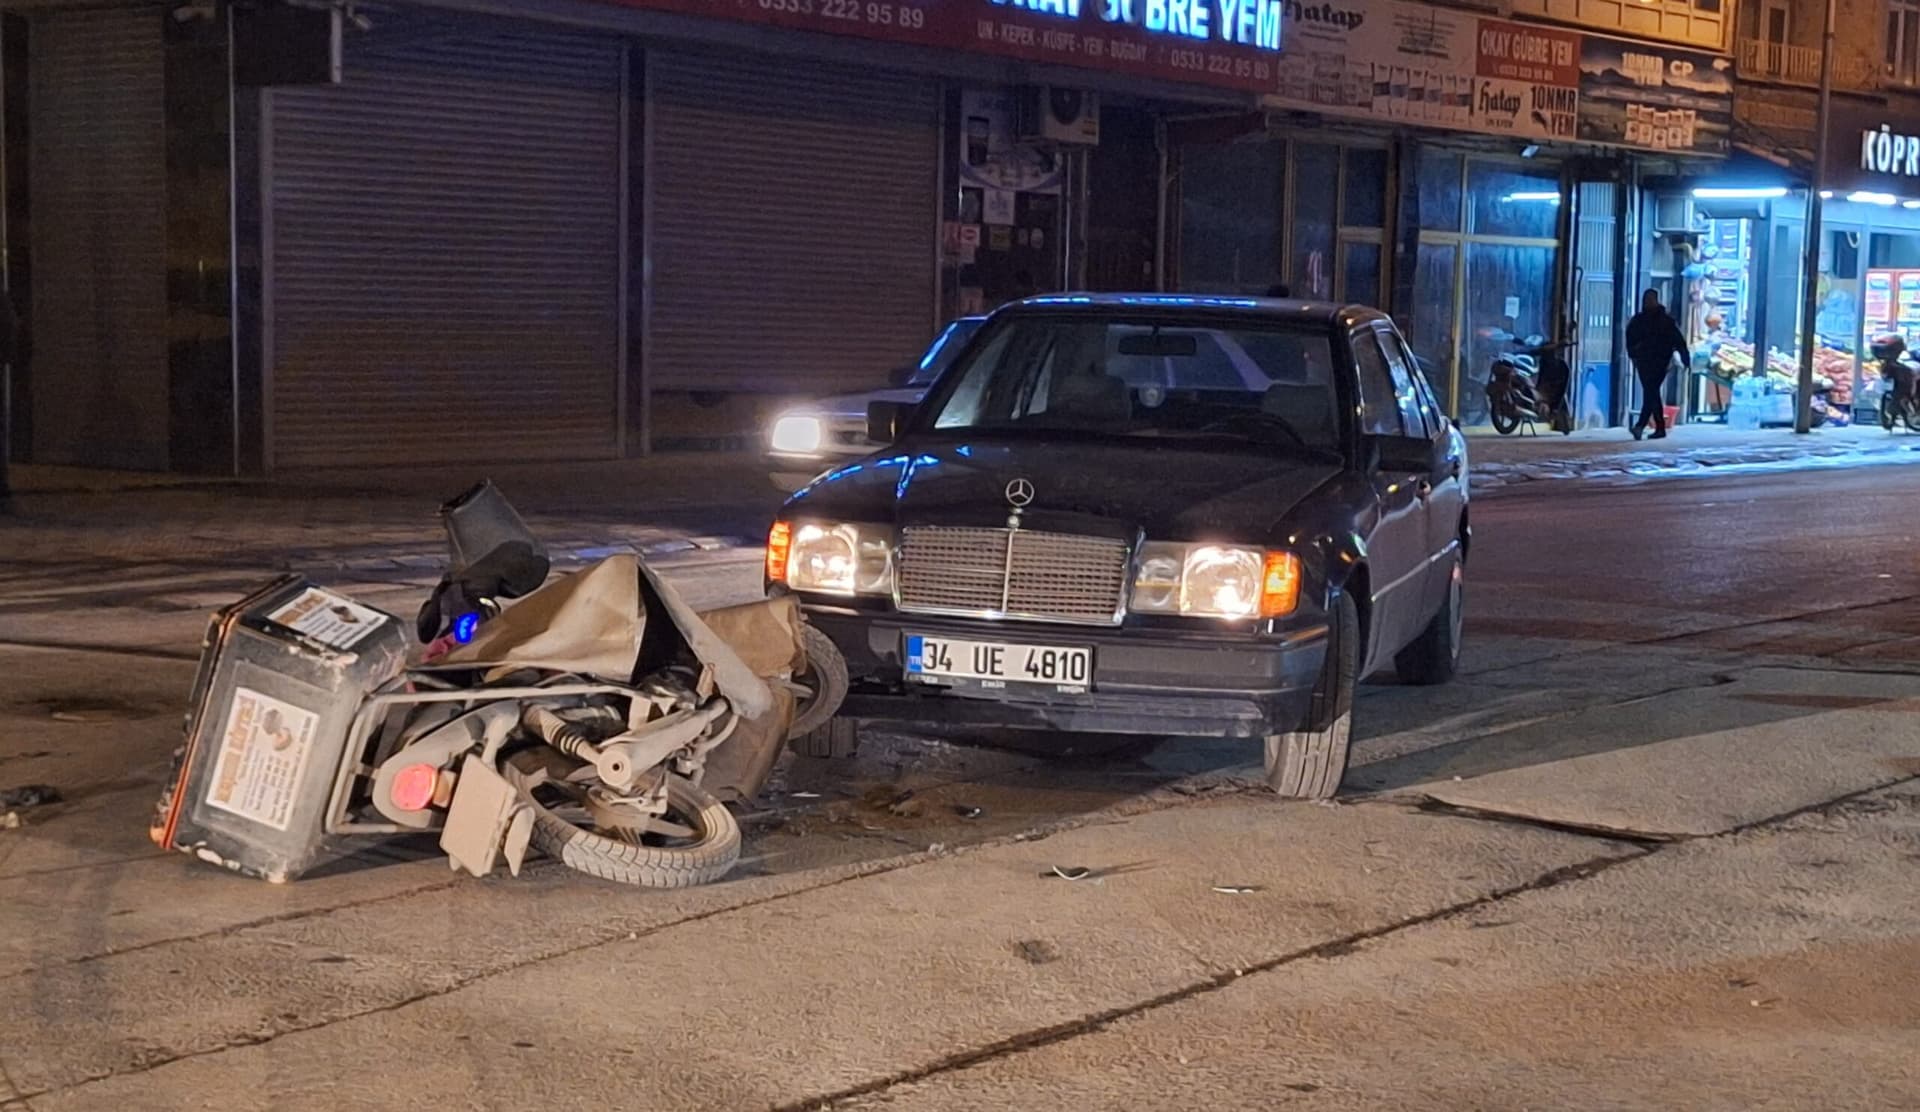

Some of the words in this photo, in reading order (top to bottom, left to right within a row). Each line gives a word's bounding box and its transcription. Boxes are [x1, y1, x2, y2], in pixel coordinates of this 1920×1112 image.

[821, 0, 860, 21] 222
[867, 3, 892, 24] 95
[899, 7, 924, 28] 89
[977, 20, 994, 40] UN
[1208, 55, 1231, 75] 222
[1480, 30, 1511, 57] OKAY
[1512, 31, 1549, 64] GÜBRE
[1670, 60, 1694, 77] CP
[1861, 123, 1920, 177] KÖPR
[923, 642, 952, 672] 34
[973, 645, 1005, 676] UE
[1025, 648, 1086, 681] 4810
